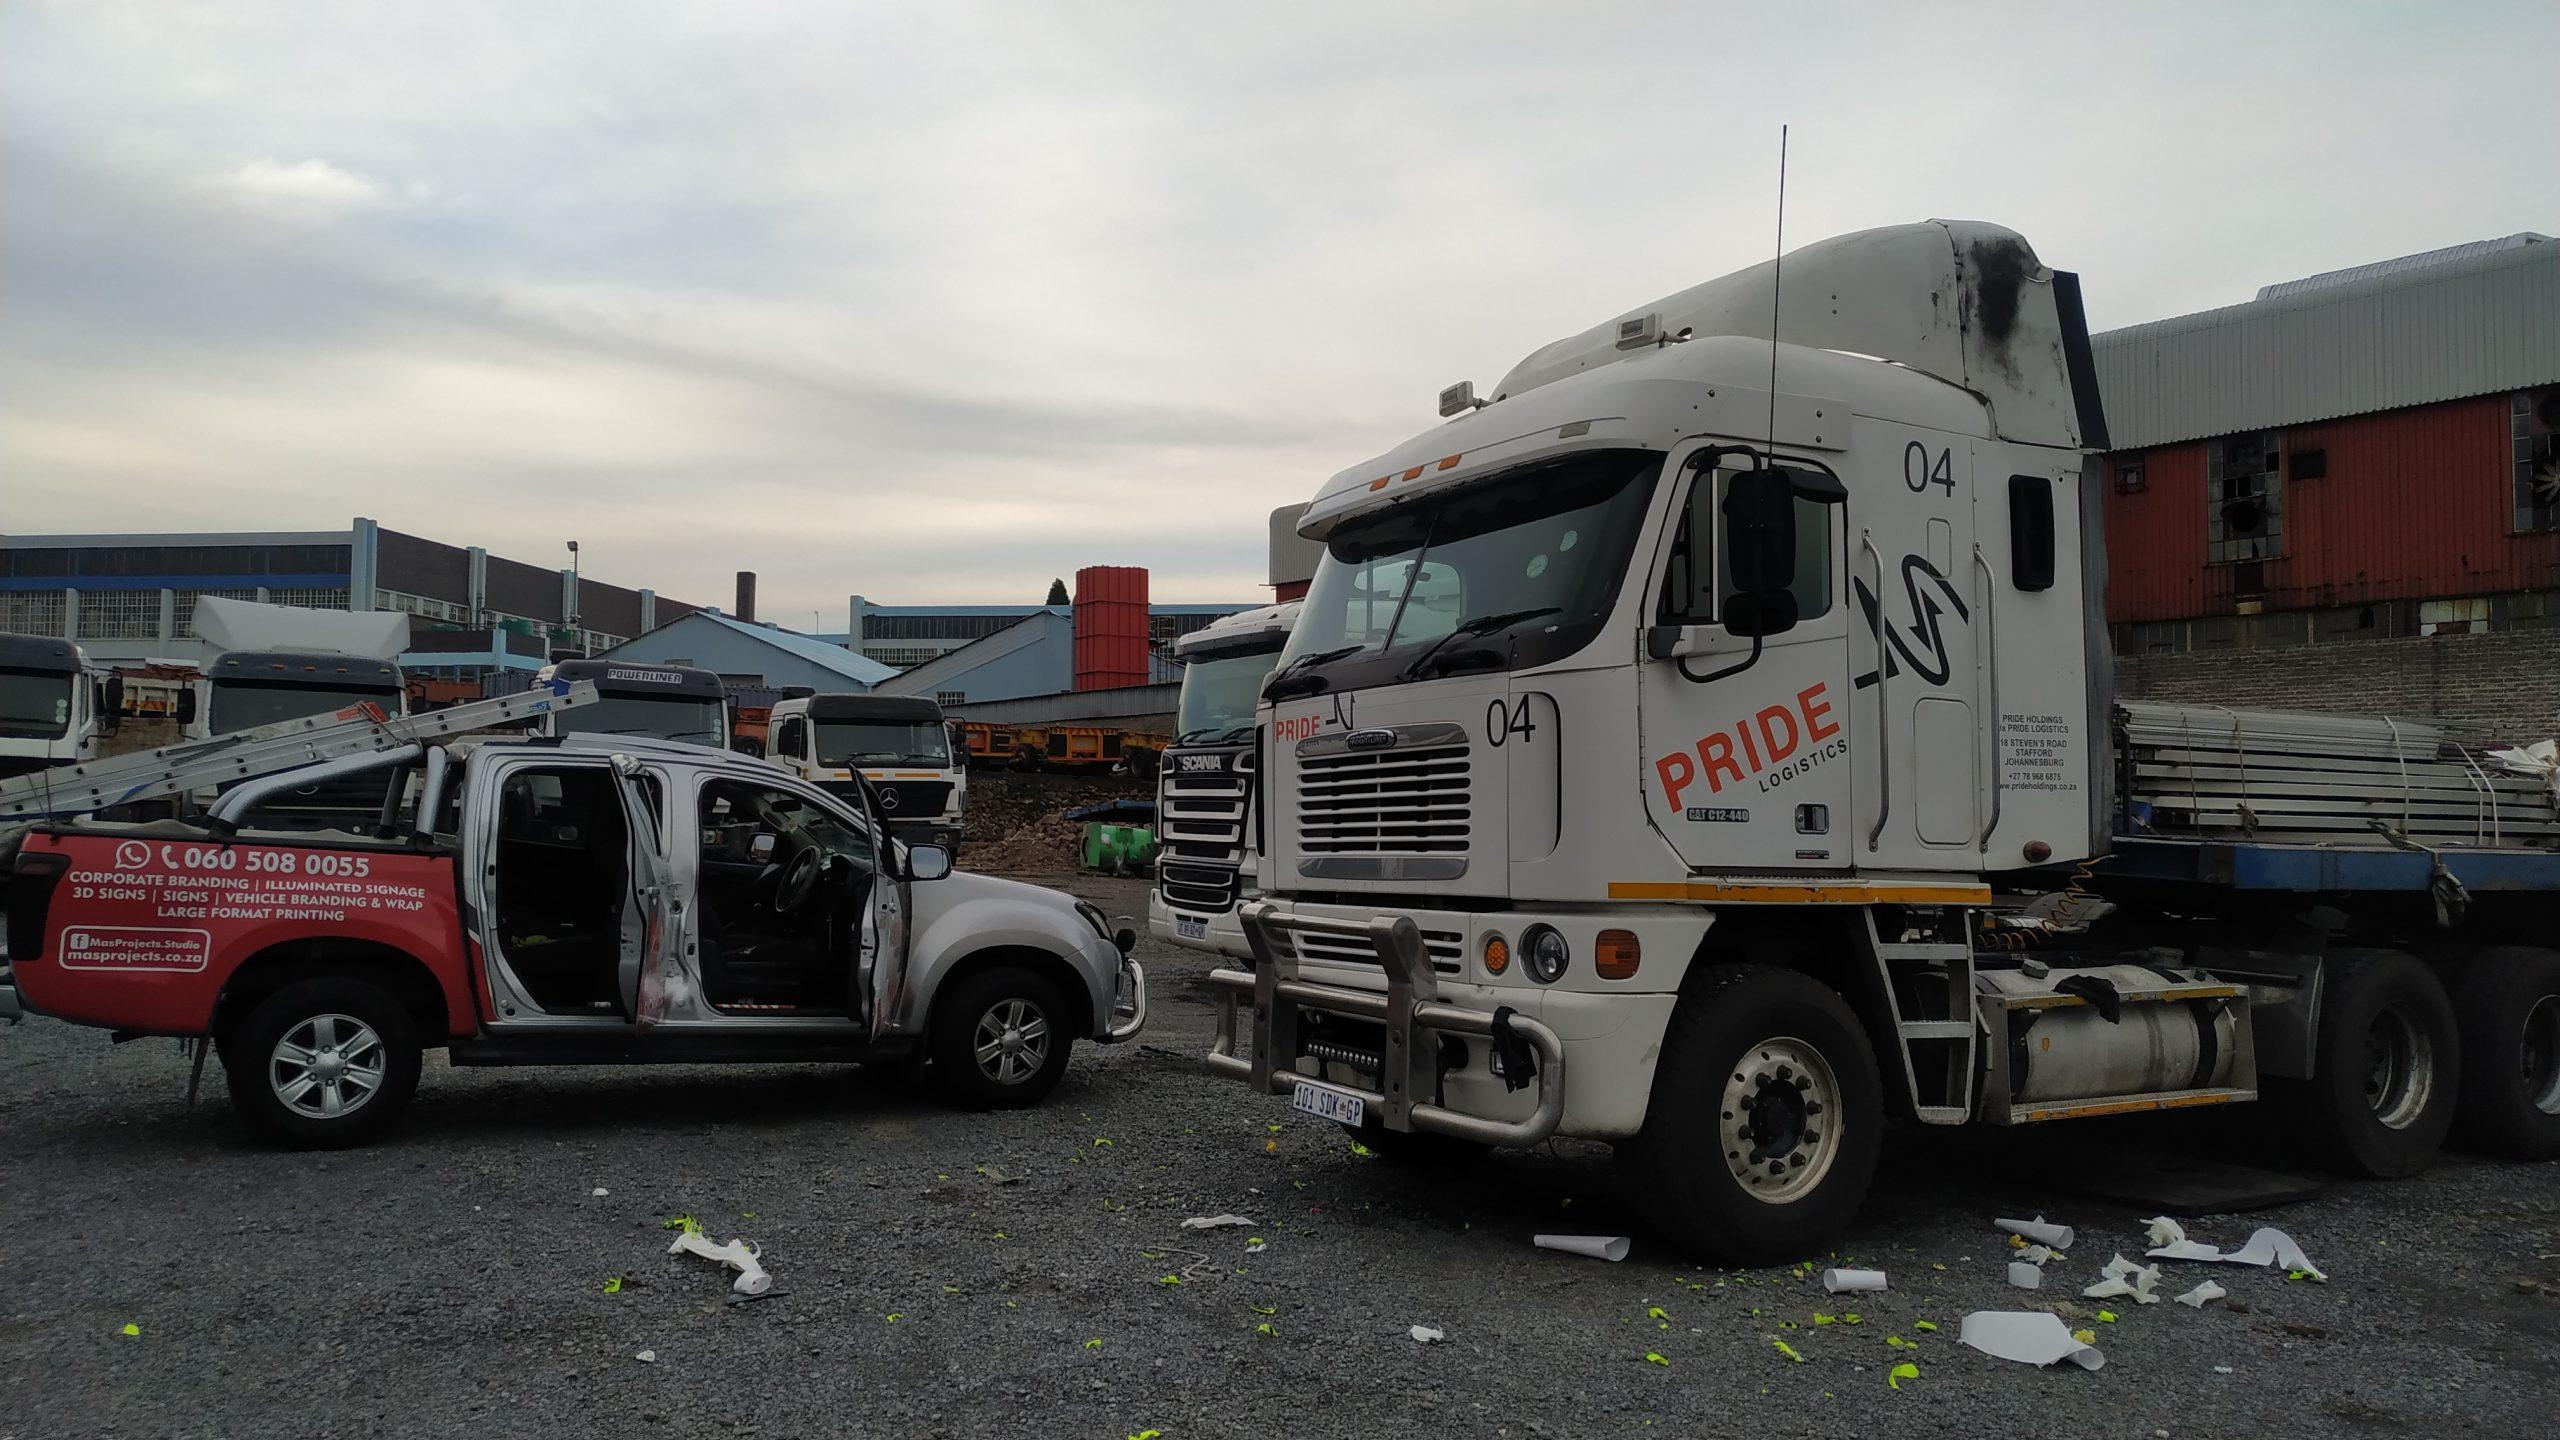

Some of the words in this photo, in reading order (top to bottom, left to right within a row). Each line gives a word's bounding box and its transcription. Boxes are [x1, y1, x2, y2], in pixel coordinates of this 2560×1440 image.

[1904, 440, 1955, 498] 04
[607, 668, 682, 684] POWERLINER
[1486, 694, 1536, 748] 04
[2002, 714, 2024, 722] PRIDE
[2026, 715, 2063, 724] HOLDINGS
[1276, 715, 1320, 743] PRIDE
[2008, 724, 2029, 732] PRIDE
[2031, 725, 2069, 733] LOGISTICS
[1656, 682, 1840, 814] PRIDE
[2016, 749, 2053, 757] STAFFORD
[1182, 755, 1222, 771] SCANIA
[1758, 738, 1848, 793] LOGISTICS
[2005, 758, 2064, 766] JOHANNESBURG
[1688, 809, 1707, 820] CAT
[184, 848, 236, 870] 060
[245, 851, 296, 873] 508
[305, 854, 369, 877] 0055
[69, 871, 164, 886] CORPORATE
[168, 876, 249, 890] BRANDING
[265, 880, 361, 893] ILLUMINATED
[366, 885, 425, 898] SIGNAGE
[72, 887, 94, 898] 3D
[99, 888, 146, 900] SIGNS
[163, 890, 209, 903] SIGNS
[225, 892, 286, 904] VEHICLE
[291, 894, 367, 908] BRANDING
[371, 898, 381, 909] &
[385, 898, 423, 911] WRAP
[157, 906, 206, 918] LARGE
[211, 907, 272, 919] FORMAT
[276, 909, 345, 922] PRINTING
[89, 938, 200, 950] MasProjects.Studio
[68, 950, 202, 963] masprojects.co.za
[1296, 1086, 1314, 1110] 101
[1319, 1092, 1339, 1116] SDK
[1347, 1100, 1360, 1122] GP
